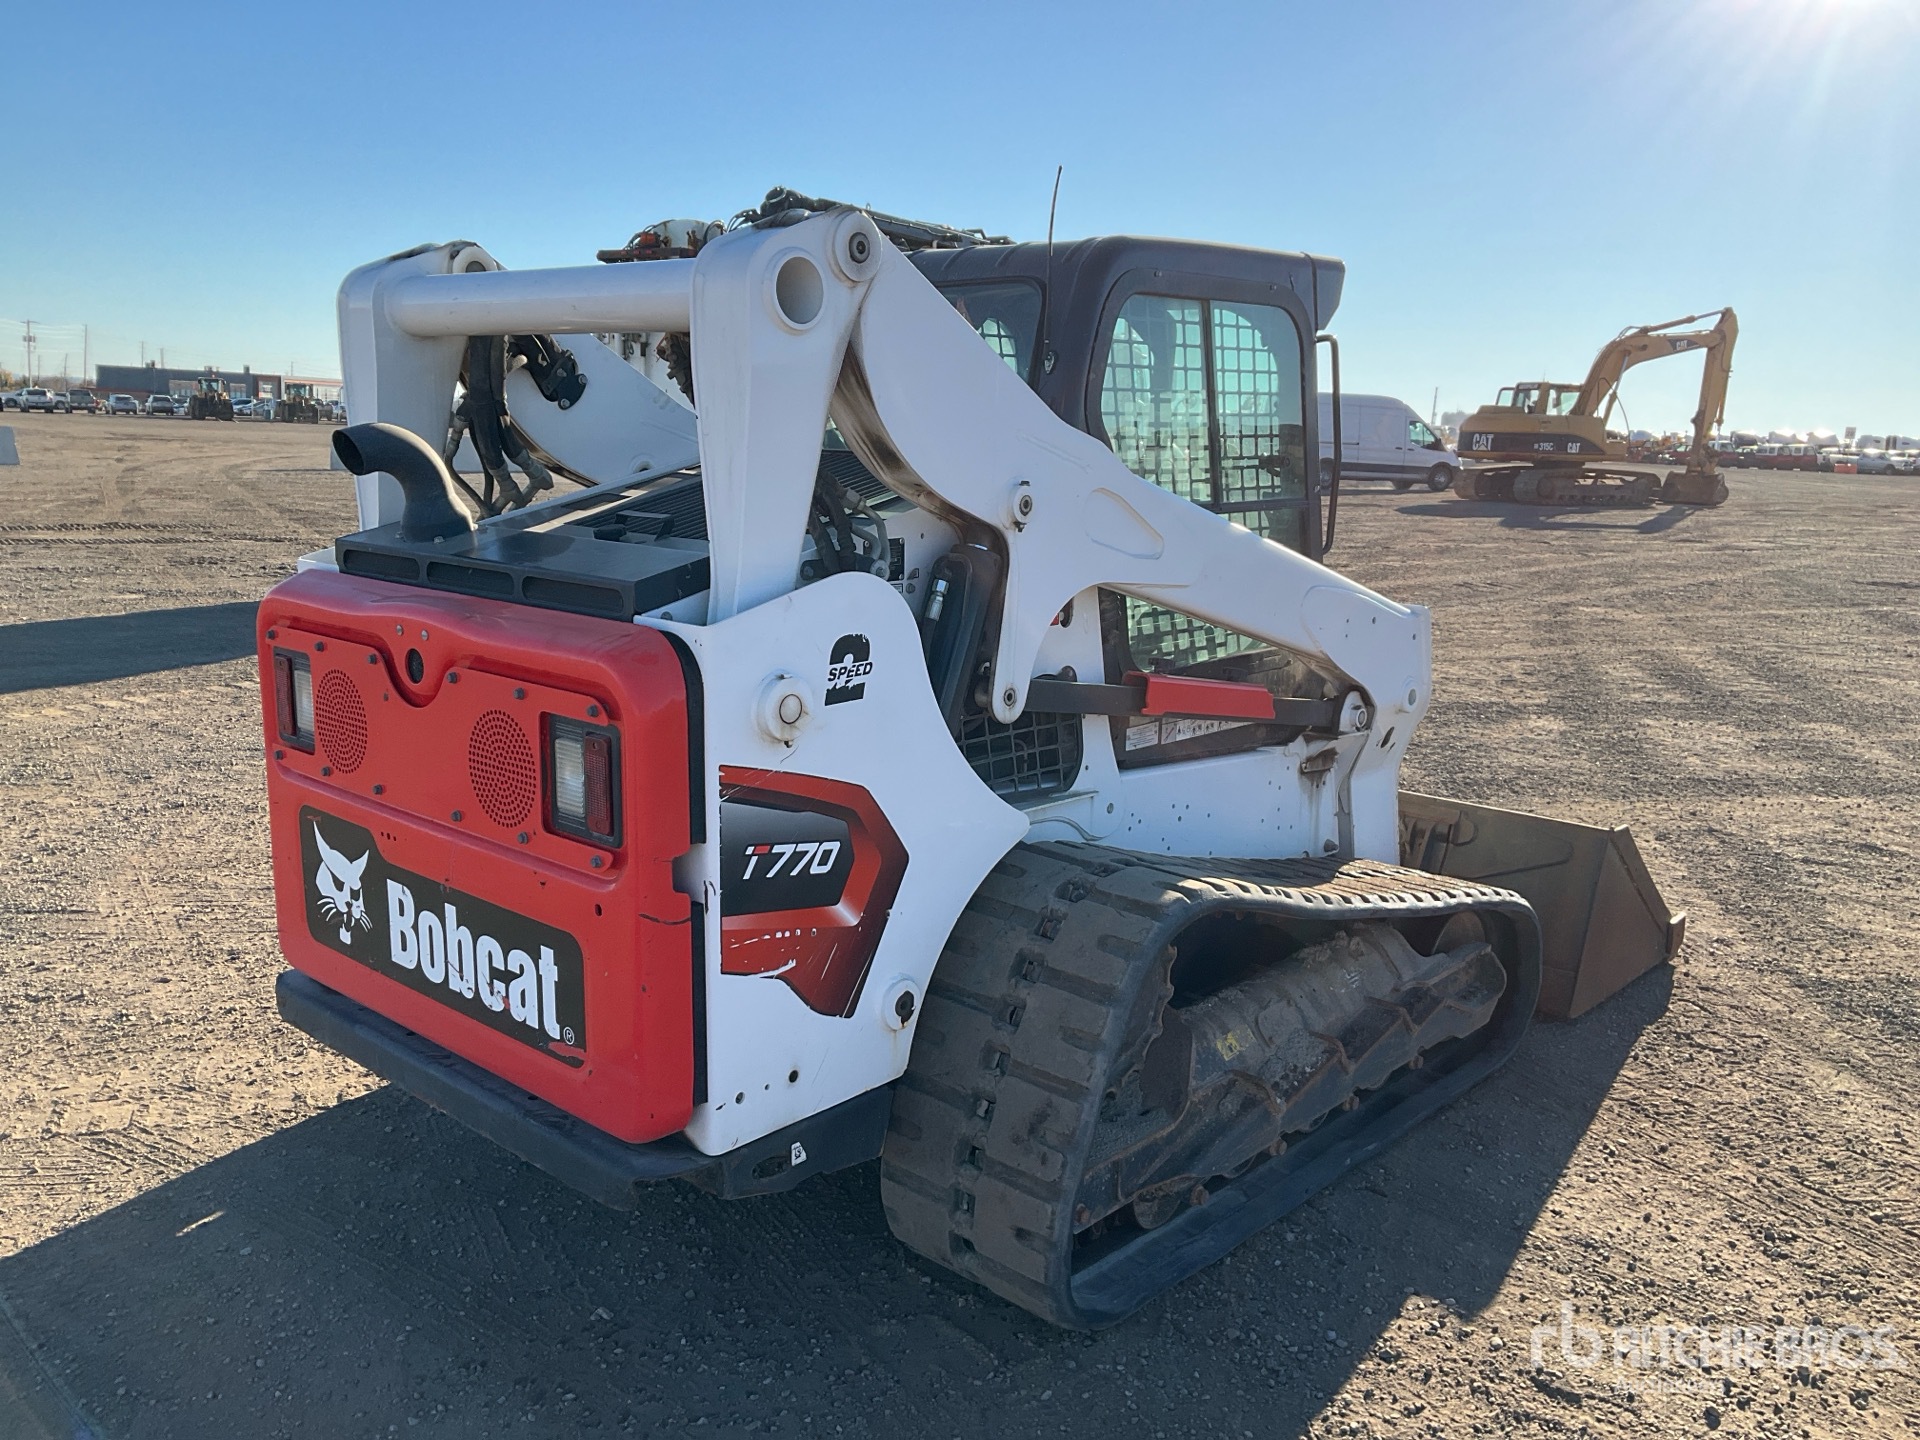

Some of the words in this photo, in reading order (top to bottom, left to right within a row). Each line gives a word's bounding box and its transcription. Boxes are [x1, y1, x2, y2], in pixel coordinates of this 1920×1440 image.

[1676, 340, 1688, 351] CAT
[1472, 433, 1494, 451] CAT
[1567, 442, 1581, 453] CAT
[827, 661, 873, 682] SPEED
[387, 879, 561, 1040] Bobcat
